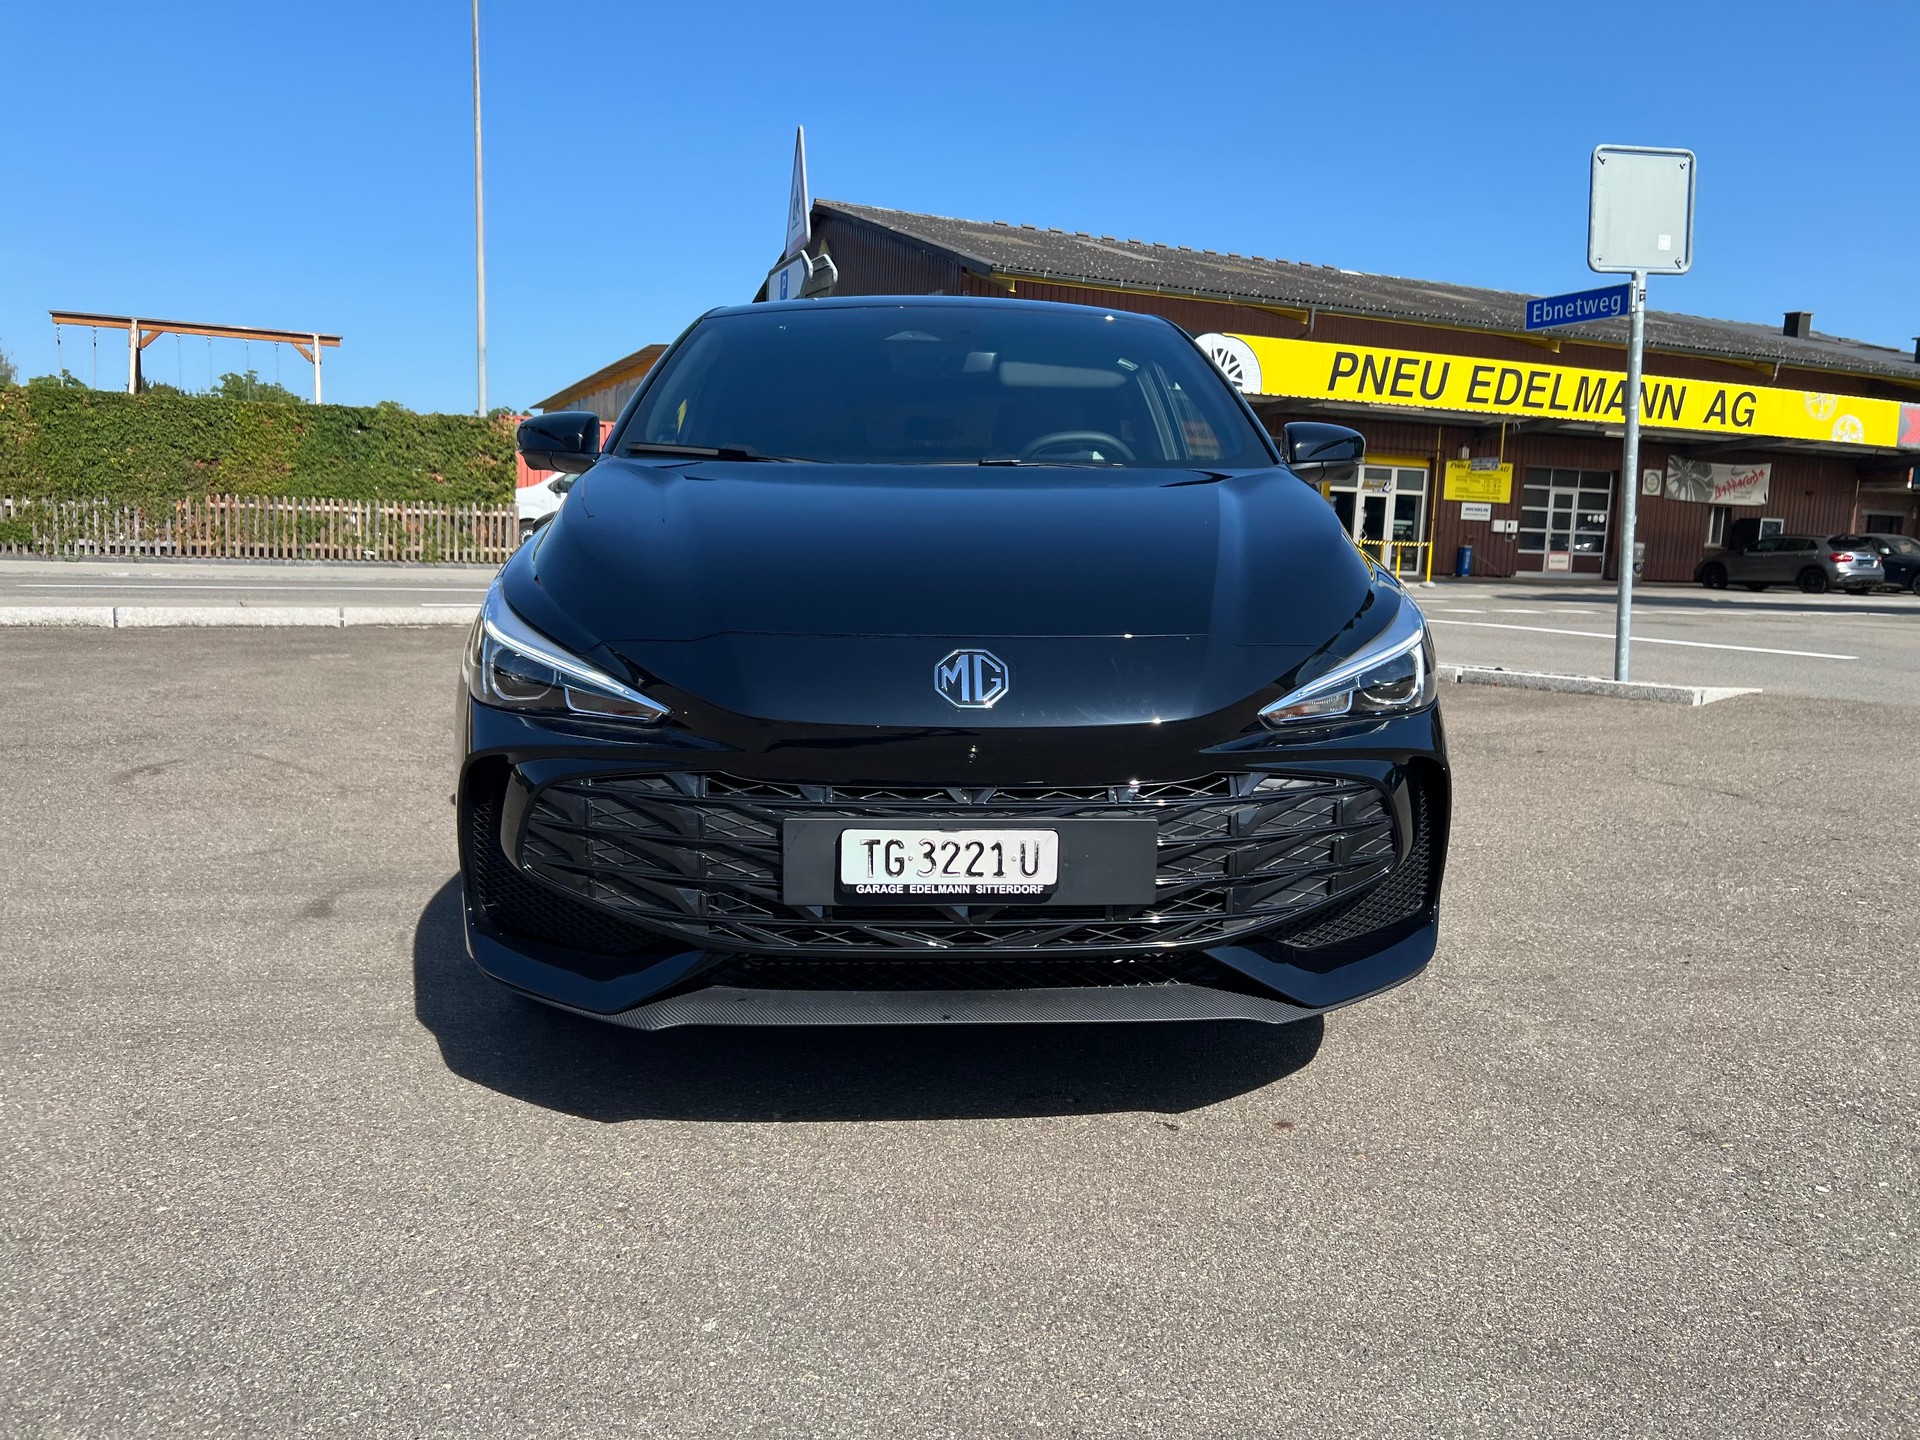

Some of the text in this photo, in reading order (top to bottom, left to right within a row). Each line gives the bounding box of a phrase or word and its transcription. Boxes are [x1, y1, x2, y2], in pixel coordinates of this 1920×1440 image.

[1533, 295, 1621, 322] Ebnetweg
[1327, 351, 1757, 427] PNEU EDELMANN AG
[941, 654, 1002, 702] MG
[860, 838, 1040, 878] TG 3221 U
[856, 884, 1044, 894] GARAGE EDELMANN SITTERDORF
